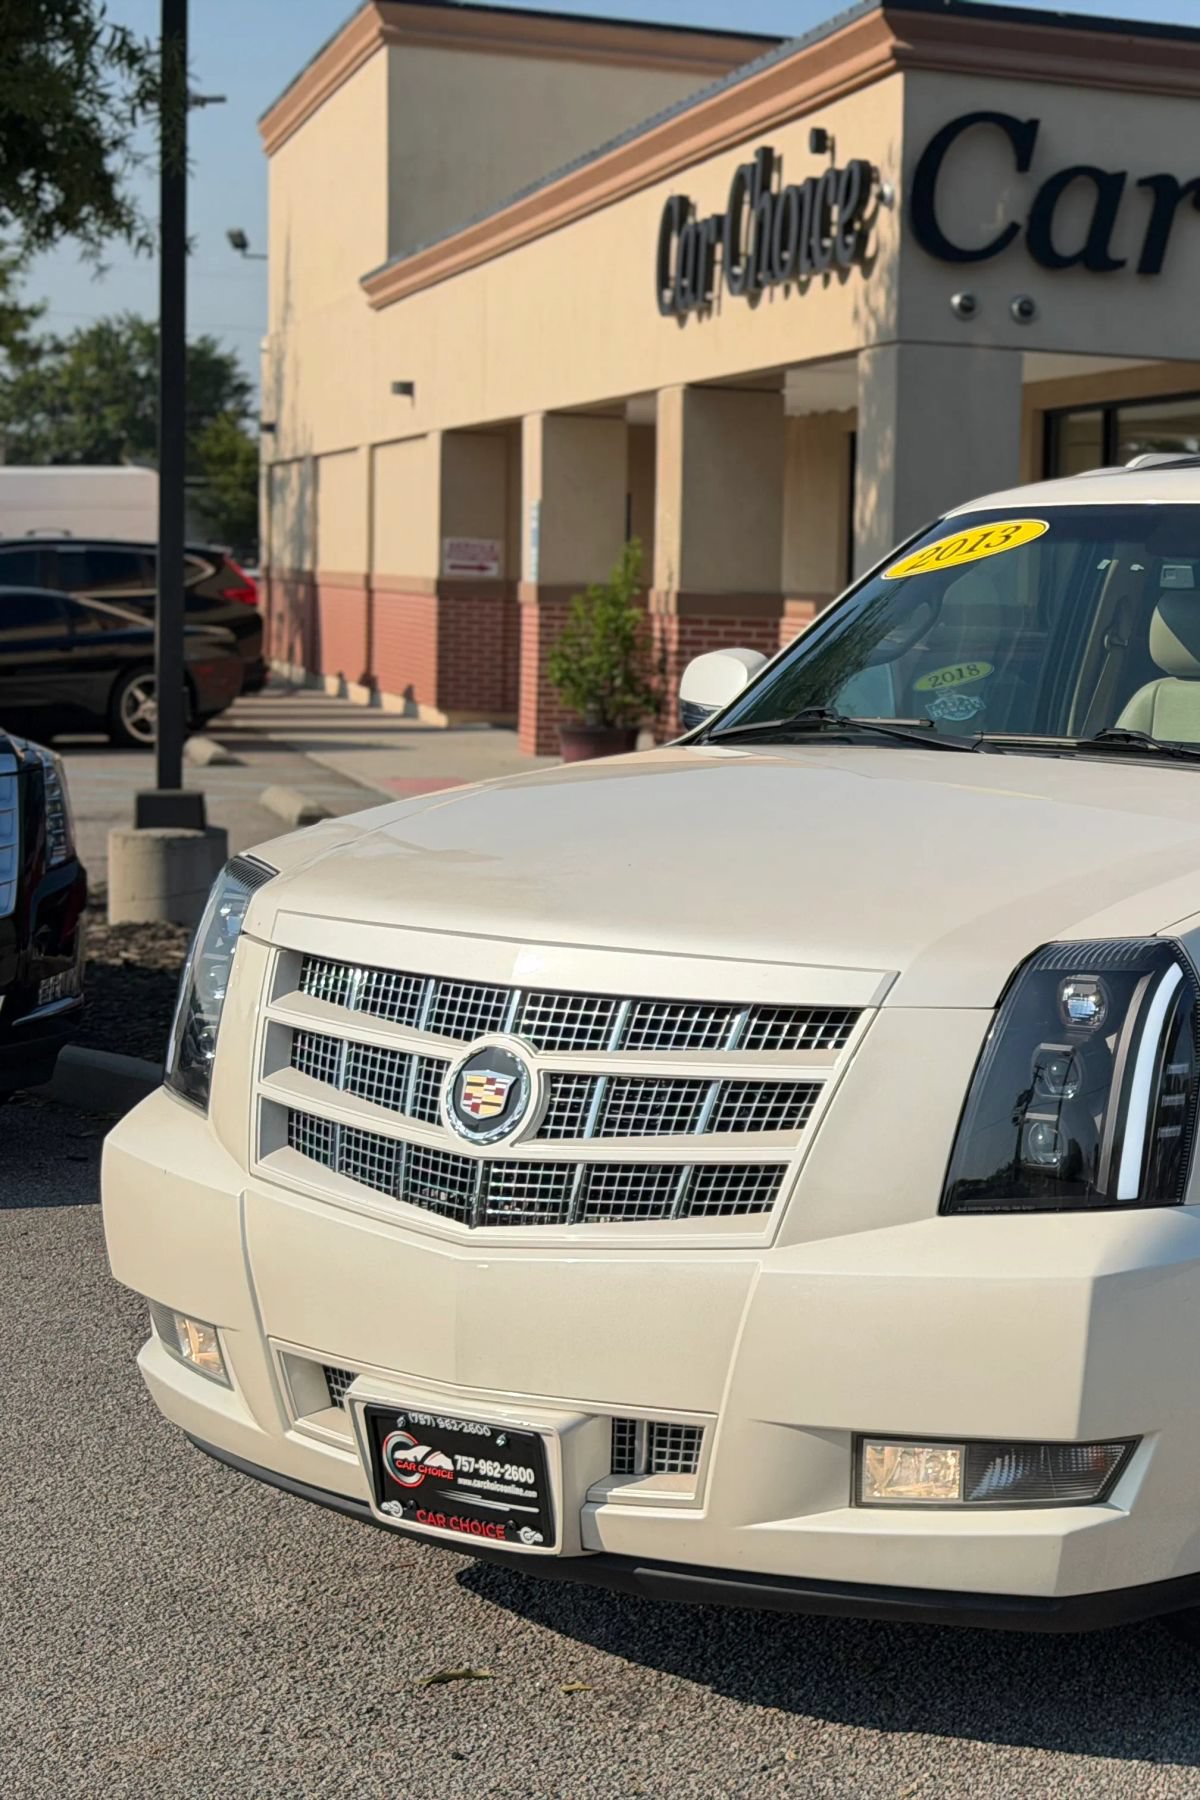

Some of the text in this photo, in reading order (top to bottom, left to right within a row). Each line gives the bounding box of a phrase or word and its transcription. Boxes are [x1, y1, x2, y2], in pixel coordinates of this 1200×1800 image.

[656, 127, 871, 317] Car Choice
[905, 525, 1022, 572] 2013
[928, 664, 980, 688] 2018
[395, 1459, 454, 1480] CAR CHOICE
[454, 1454, 535, 1484] 757-962-2600
[416, 1510, 506, 1541] CAR CHOICE
